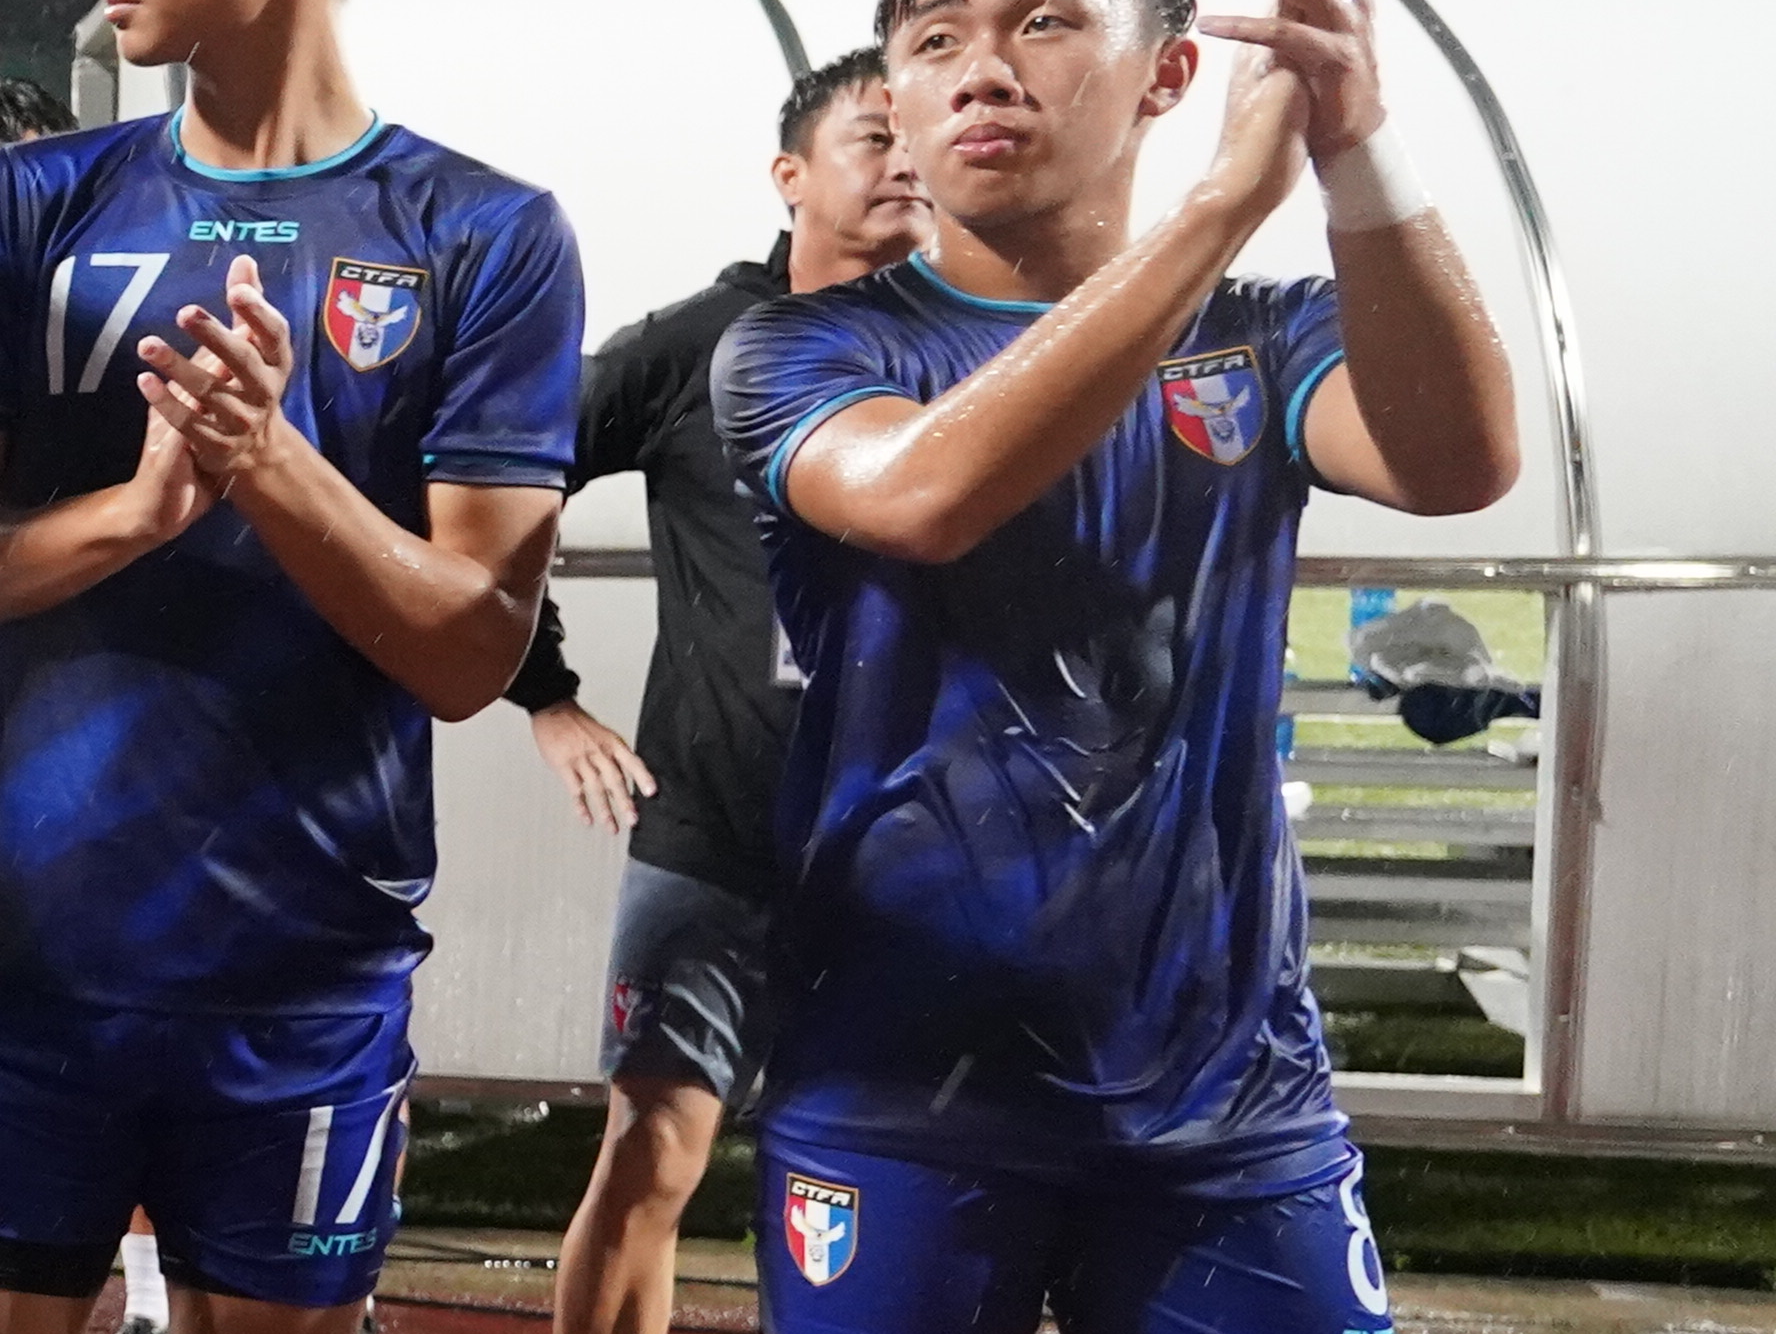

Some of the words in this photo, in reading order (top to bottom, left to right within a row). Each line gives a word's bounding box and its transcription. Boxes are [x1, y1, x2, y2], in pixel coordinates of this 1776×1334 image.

[188, 220, 301, 243] ENTES
[340, 266, 419, 288] CTFA
[46, 252, 171, 395] 17
[1164, 354, 1245, 380] CTFA
[292, 1079, 410, 1226] 17
[791, 1180, 852, 1207] CTFA
[288, 1228, 378, 1256] ENTES
[1339, 1159, 1389, 1316] 8
